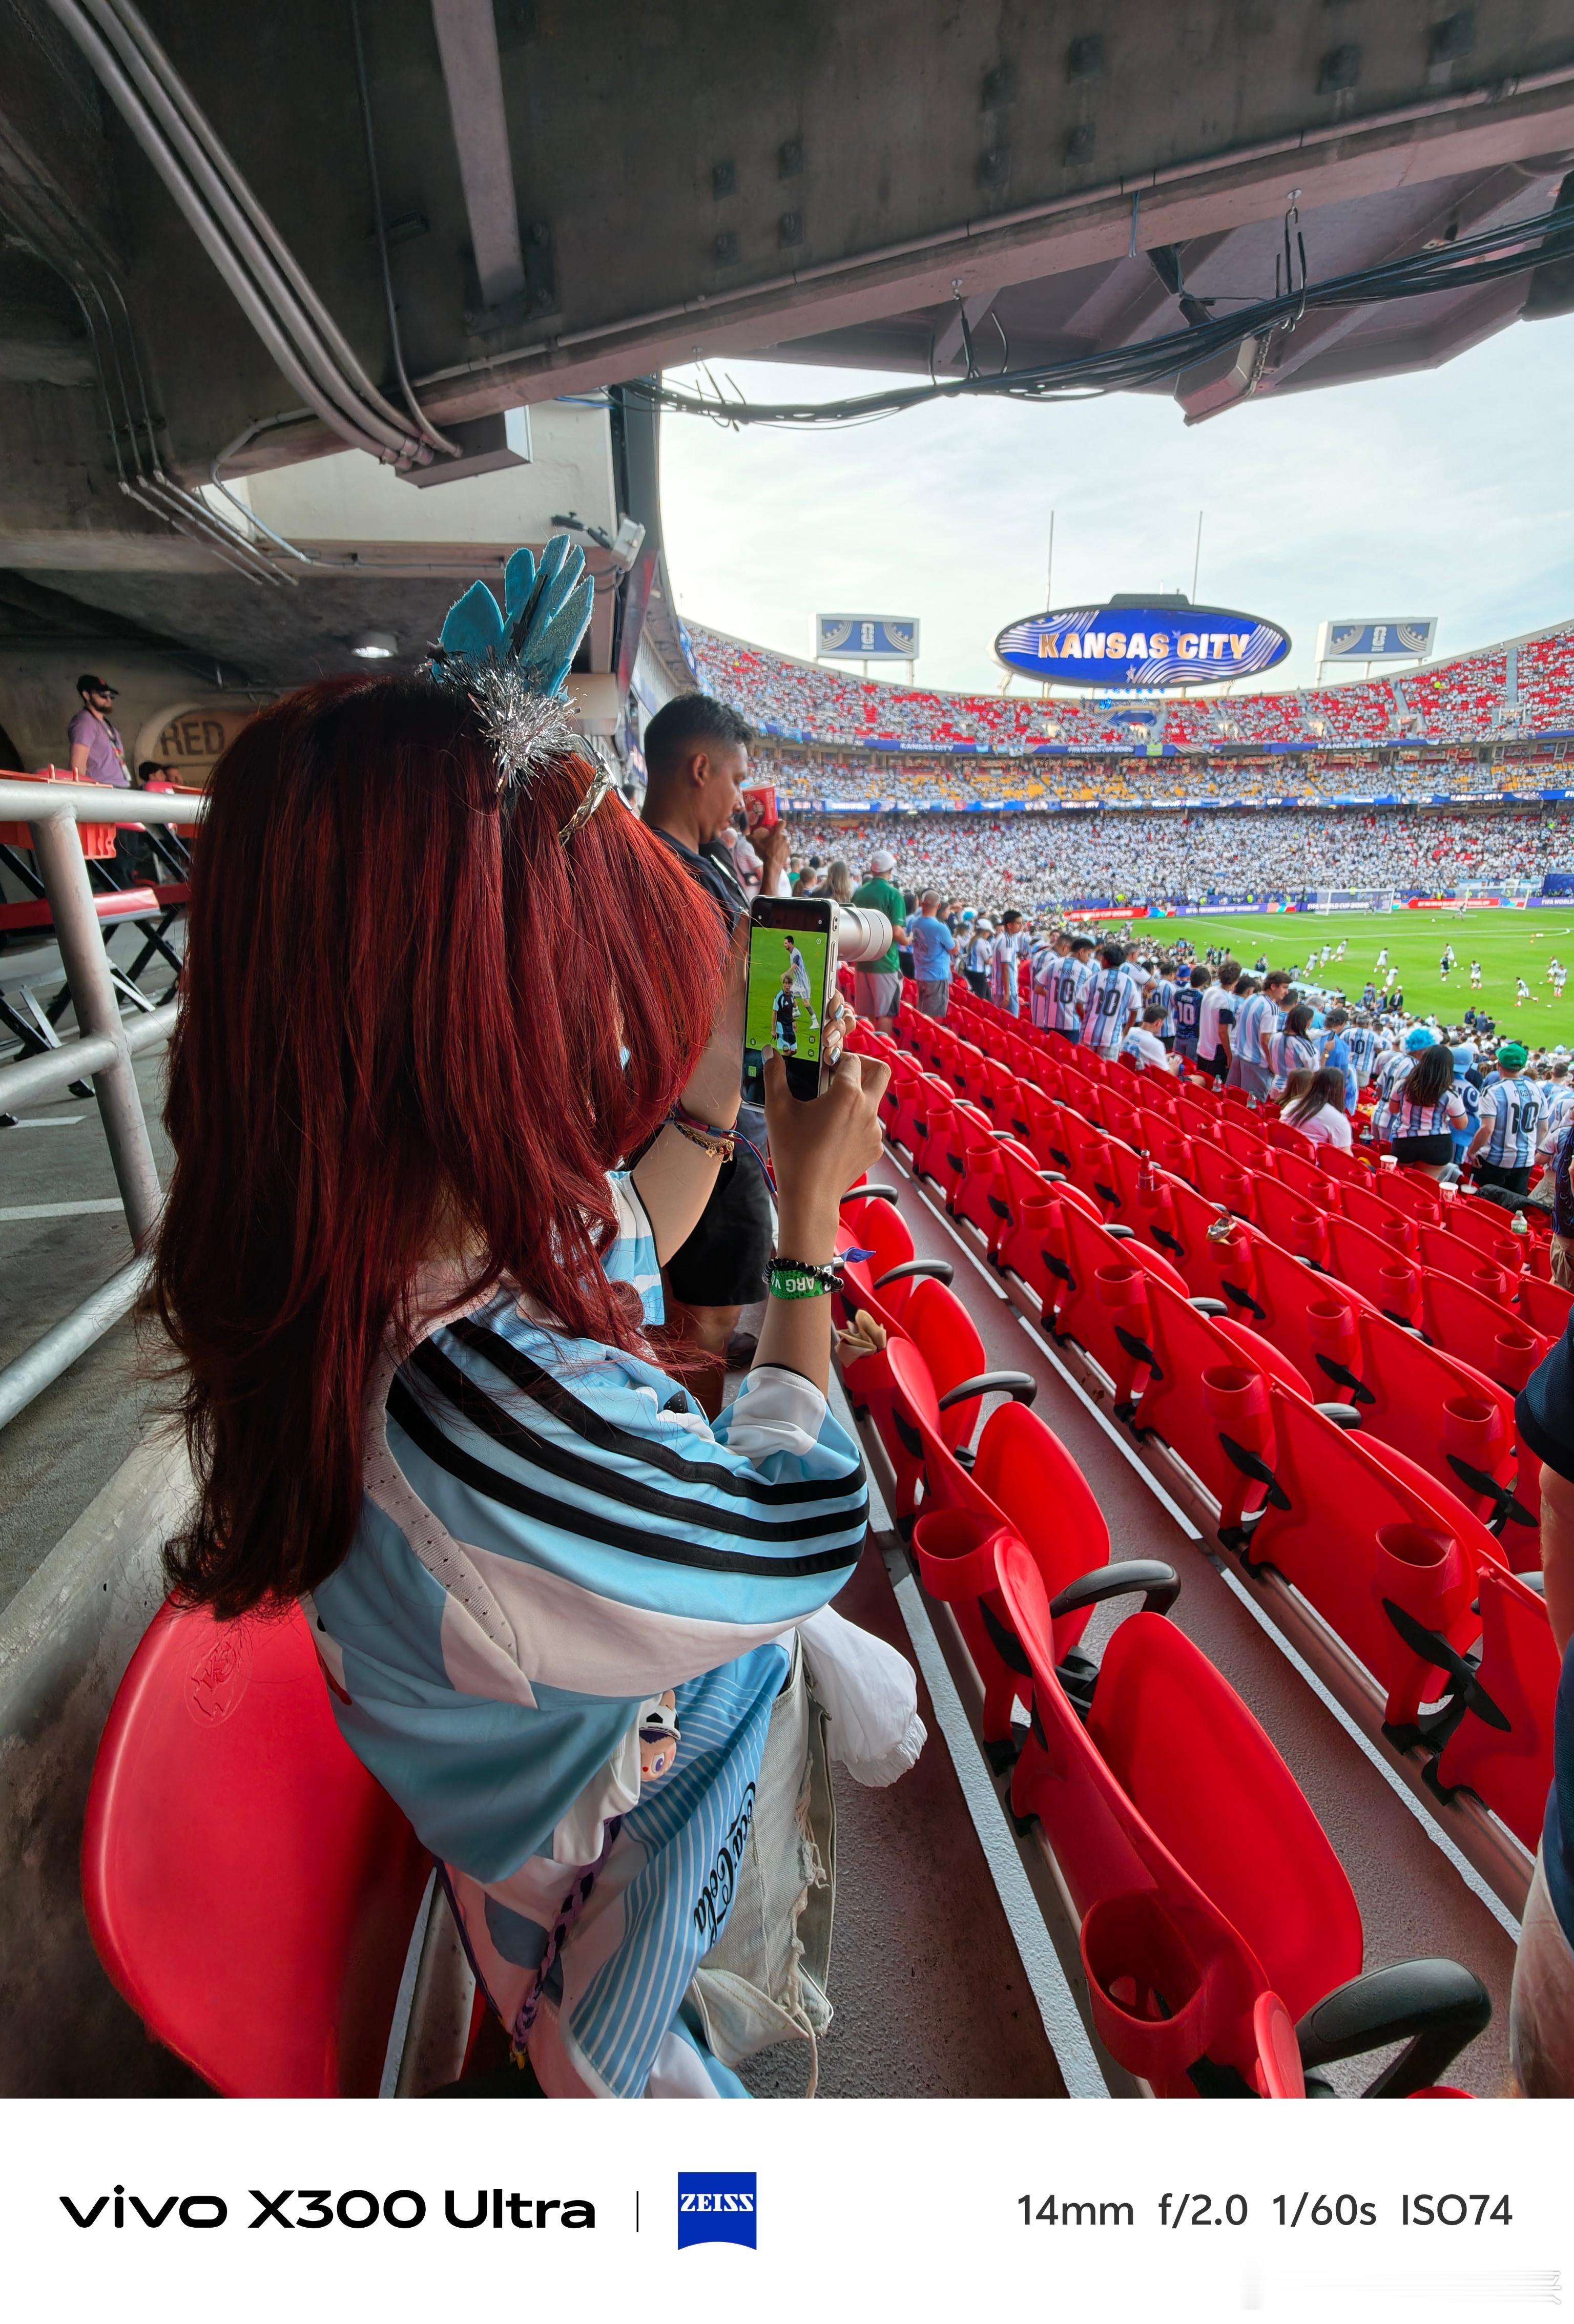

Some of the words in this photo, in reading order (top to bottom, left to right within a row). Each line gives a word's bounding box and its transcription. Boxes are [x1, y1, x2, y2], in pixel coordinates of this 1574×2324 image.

[1038, 632, 1169, 659] KANSAS
[1177, 633, 1249, 659] CITY
[160, 721, 224, 756] RED
[1054, 976, 1075, 1004] 10
[1095, 987, 1121, 1016] 10
[1177, 1001, 1195, 1025] 10
[1350, 1039, 1365, 1054] 10
[1511, 1102, 1539, 1133] 10
[785, 1277, 815, 1292] ARG
[694, 1781, 756, 1949] Coca-Cola
